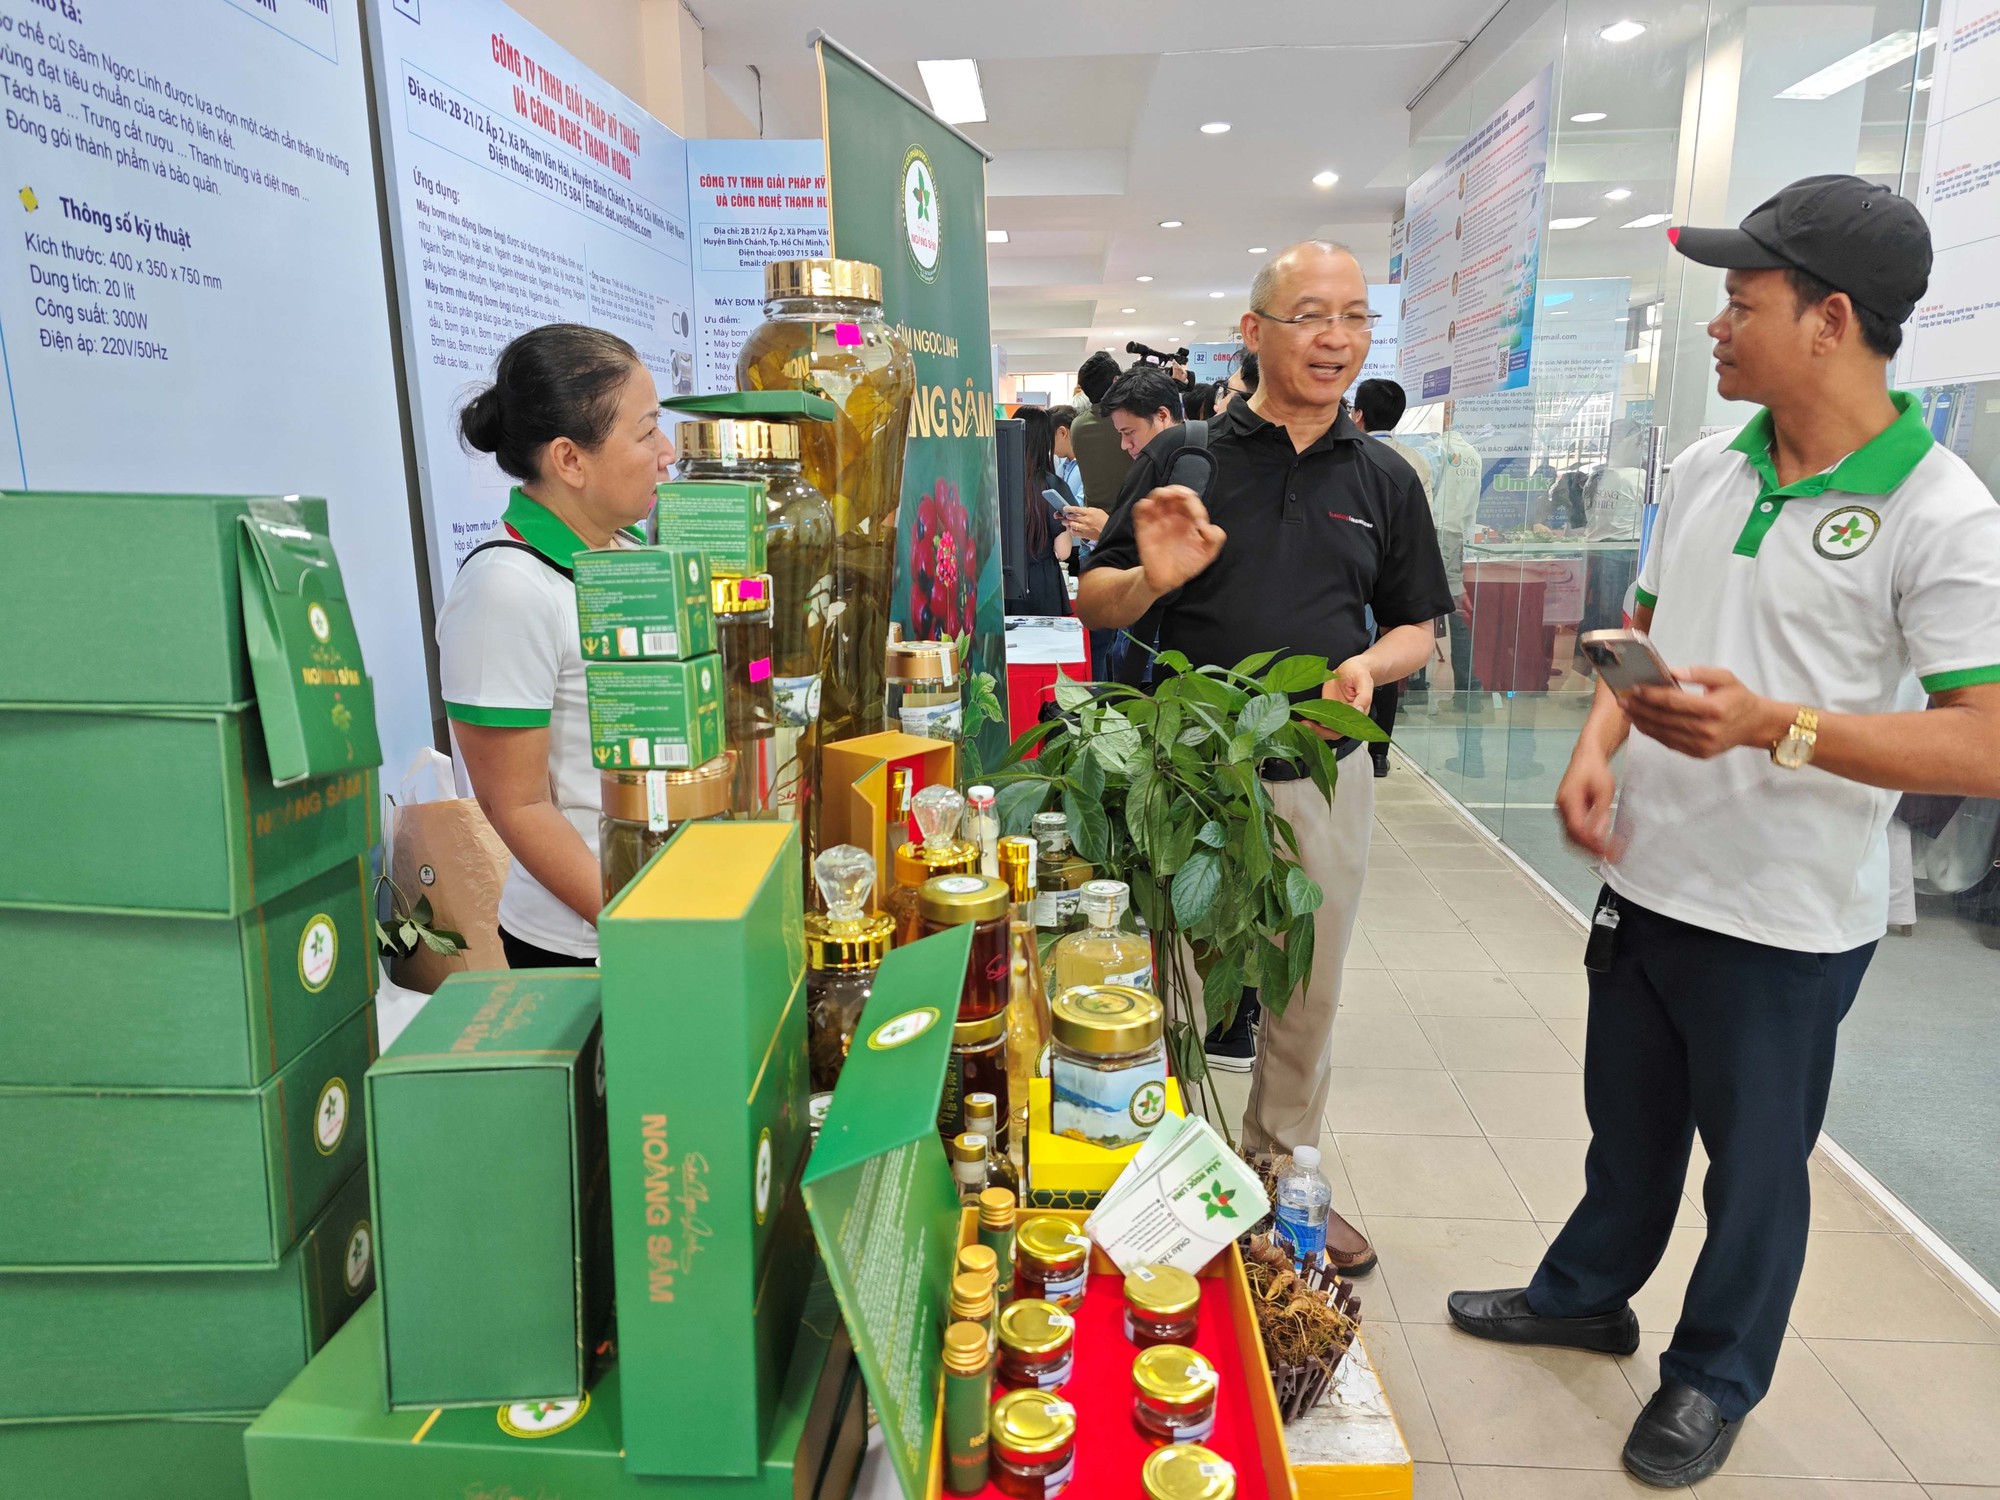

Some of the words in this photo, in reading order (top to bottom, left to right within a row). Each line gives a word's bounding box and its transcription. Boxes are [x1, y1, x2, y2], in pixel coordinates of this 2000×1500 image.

[18, 20, 44, 45] chế
[49, 32, 65, 54] củ
[68, 39, 99, 68] Sâm
[102, 53, 135, 84] Ngọc
[137, 68, 162, 94] Linh
[165, 82, 194, 108] được
[195, 94, 213, 115] lựa
[215, 104, 238, 127] chọn
[240, 117, 258, 136] một
[260, 124, 280, 145] cách
[282, 130, 297, 151] cẩn
[298, 140, 315, 159] thận
[326, 152, 350, 176] những
[38, 58, 61, 85] đạt
[64, 68, 89, 94] tiêu
[92, 81, 131, 110] chuẩn
[134, 97, 155, 120] của
[159, 108, 179, 128] các
[181, 114, 195, 135] hộ
[197, 121, 216, 144] liên
[217, 129, 235, 150] kết.
[492, 33, 522, 78] CÔNG
[523, 55, 535, 87] TY
[538, 65, 563, 104] TNHH
[565, 83, 583, 118] GIẢI
[585, 99, 606, 133] PHÁP
[608, 113, 618, 141] KỸ
[619, 122, 640, 159] THUẬT
[0, 74, 39, 106] Tách
[43, 90, 61, 113] bã
[81, 103, 121, 138] Trưng
[124, 120, 143, 143] cất
[145, 133, 173, 153] rượu
[189, 143, 222, 171] Thanh
[224, 158, 249, 184] trùng
[250, 169, 262, 185] và
[264, 173, 281, 192] diệt
[282, 182, 300, 198] men
[6, 108, 47, 144] Đóng
[51, 127, 72, 148] gói
[75, 133, 112, 161] thành
[116, 147, 149, 173] phẩm
[153, 160, 166, 178] và
[169, 164, 190, 186] bảo
[194, 176, 221, 196] quản.
[408, 76, 427, 105] Địa
[429, 89, 447, 114] chỉ:
[448, 99, 461, 121] 2B
[463, 107, 484, 133] 21/2
[486, 115, 498, 143] Ấp
[499, 127, 508, 147] 2,
[508, 131, 519, 152] Xã
[520, 137, 542, 164] Phạm
[542, 151, 557, 173] Văn
[558, 159, 571, 181] Hai,
[572, 167, 592, 193] Huyện
[593, 179, 607, 199] Bình
[513, 84, 527, 118] VÀ
[530, 95, 556, 136] CÔNG
[558, 114, 582, 155] NGHỆ
[583, 130, 609, 166] THẠNH
[612, 147, 631, 181] HƯNG
[413, 165, 434, 195] Ứng
[436, 180, 460, 205] dụng:
[488, 143, 509, 170] Điện
[510, 155, 534, 182] thoại:
[535, 168, 553, 190] 0903
[554, 178, 567, 197] 715
[569, 185, 581, 204] 584
[700, 174, 724, 188] CÔNG
[727, 176, 737, 188] TY
[740, 176, 764, 188] TNHH
[767, 173, 785, 189] GIẢI
[789, 175, 812, 189] PHÁP
[716, 192, 728, 207] VÀ
[731, 193, 755, 207] CÔNG
[758, 194, 782, 210] NGHỆ
[784, 196, 814, 210] THẠNH
[59, 196, 113, 233] Thông
[115, 211, 132, 233] số
[134, 215, 152, 242] kỹ
[155, 222, 192, 252] thuật
[704, 238, 726, 247] Huyện
[728, 238, 743, 246] Bình
[714, 227, 726, 236] Địa
[727, 227, 740, 235] chỉ:
[751, 227, 767, 235] 21/2
[797, 228, 816, 237] Phạm
[25, 231, 58, 257] Kích
[61, 240, 107, 266] thước:
[109, 250, 133, 272] 400
[136, 260, 144, 274] x
[146, 258, 168, 279] 350
[170, 267, 178, 281] x
[179, 266, 201, 285] 750
[203, 274, 223, 290] mm
[739, 248, 755, 258] Điện
[756, 249, 776, 258] thoại:
[30, 264, 70, 294] Dung
[72, 271, 101, 295] tích:
[104, 279, 121, 298] 20
[123, 281, 136, 301] lít
[715, 297, 733, 306] MÁY
[735, 298, 755, 306] BƠM
[35, 296, 74, 324] Công
[77, 302, 109, 325] suất:
[112, 309, 148, 330] 300W
[39, 328, 73, 353] Điện
[77, 333, 98, 356] áp:
[101, 337, 168, 360] 220V/50Hz
[713, 329, 729, 338] Máy
[914, 329, 942, 359] NGỌC
[943, 334, 958, 359] LINH
[1197, 354, 1205, 362] 32
[641, 1114, 676, 1226] NOÀNG
[647, 1234, 678, 1304] SÂM
